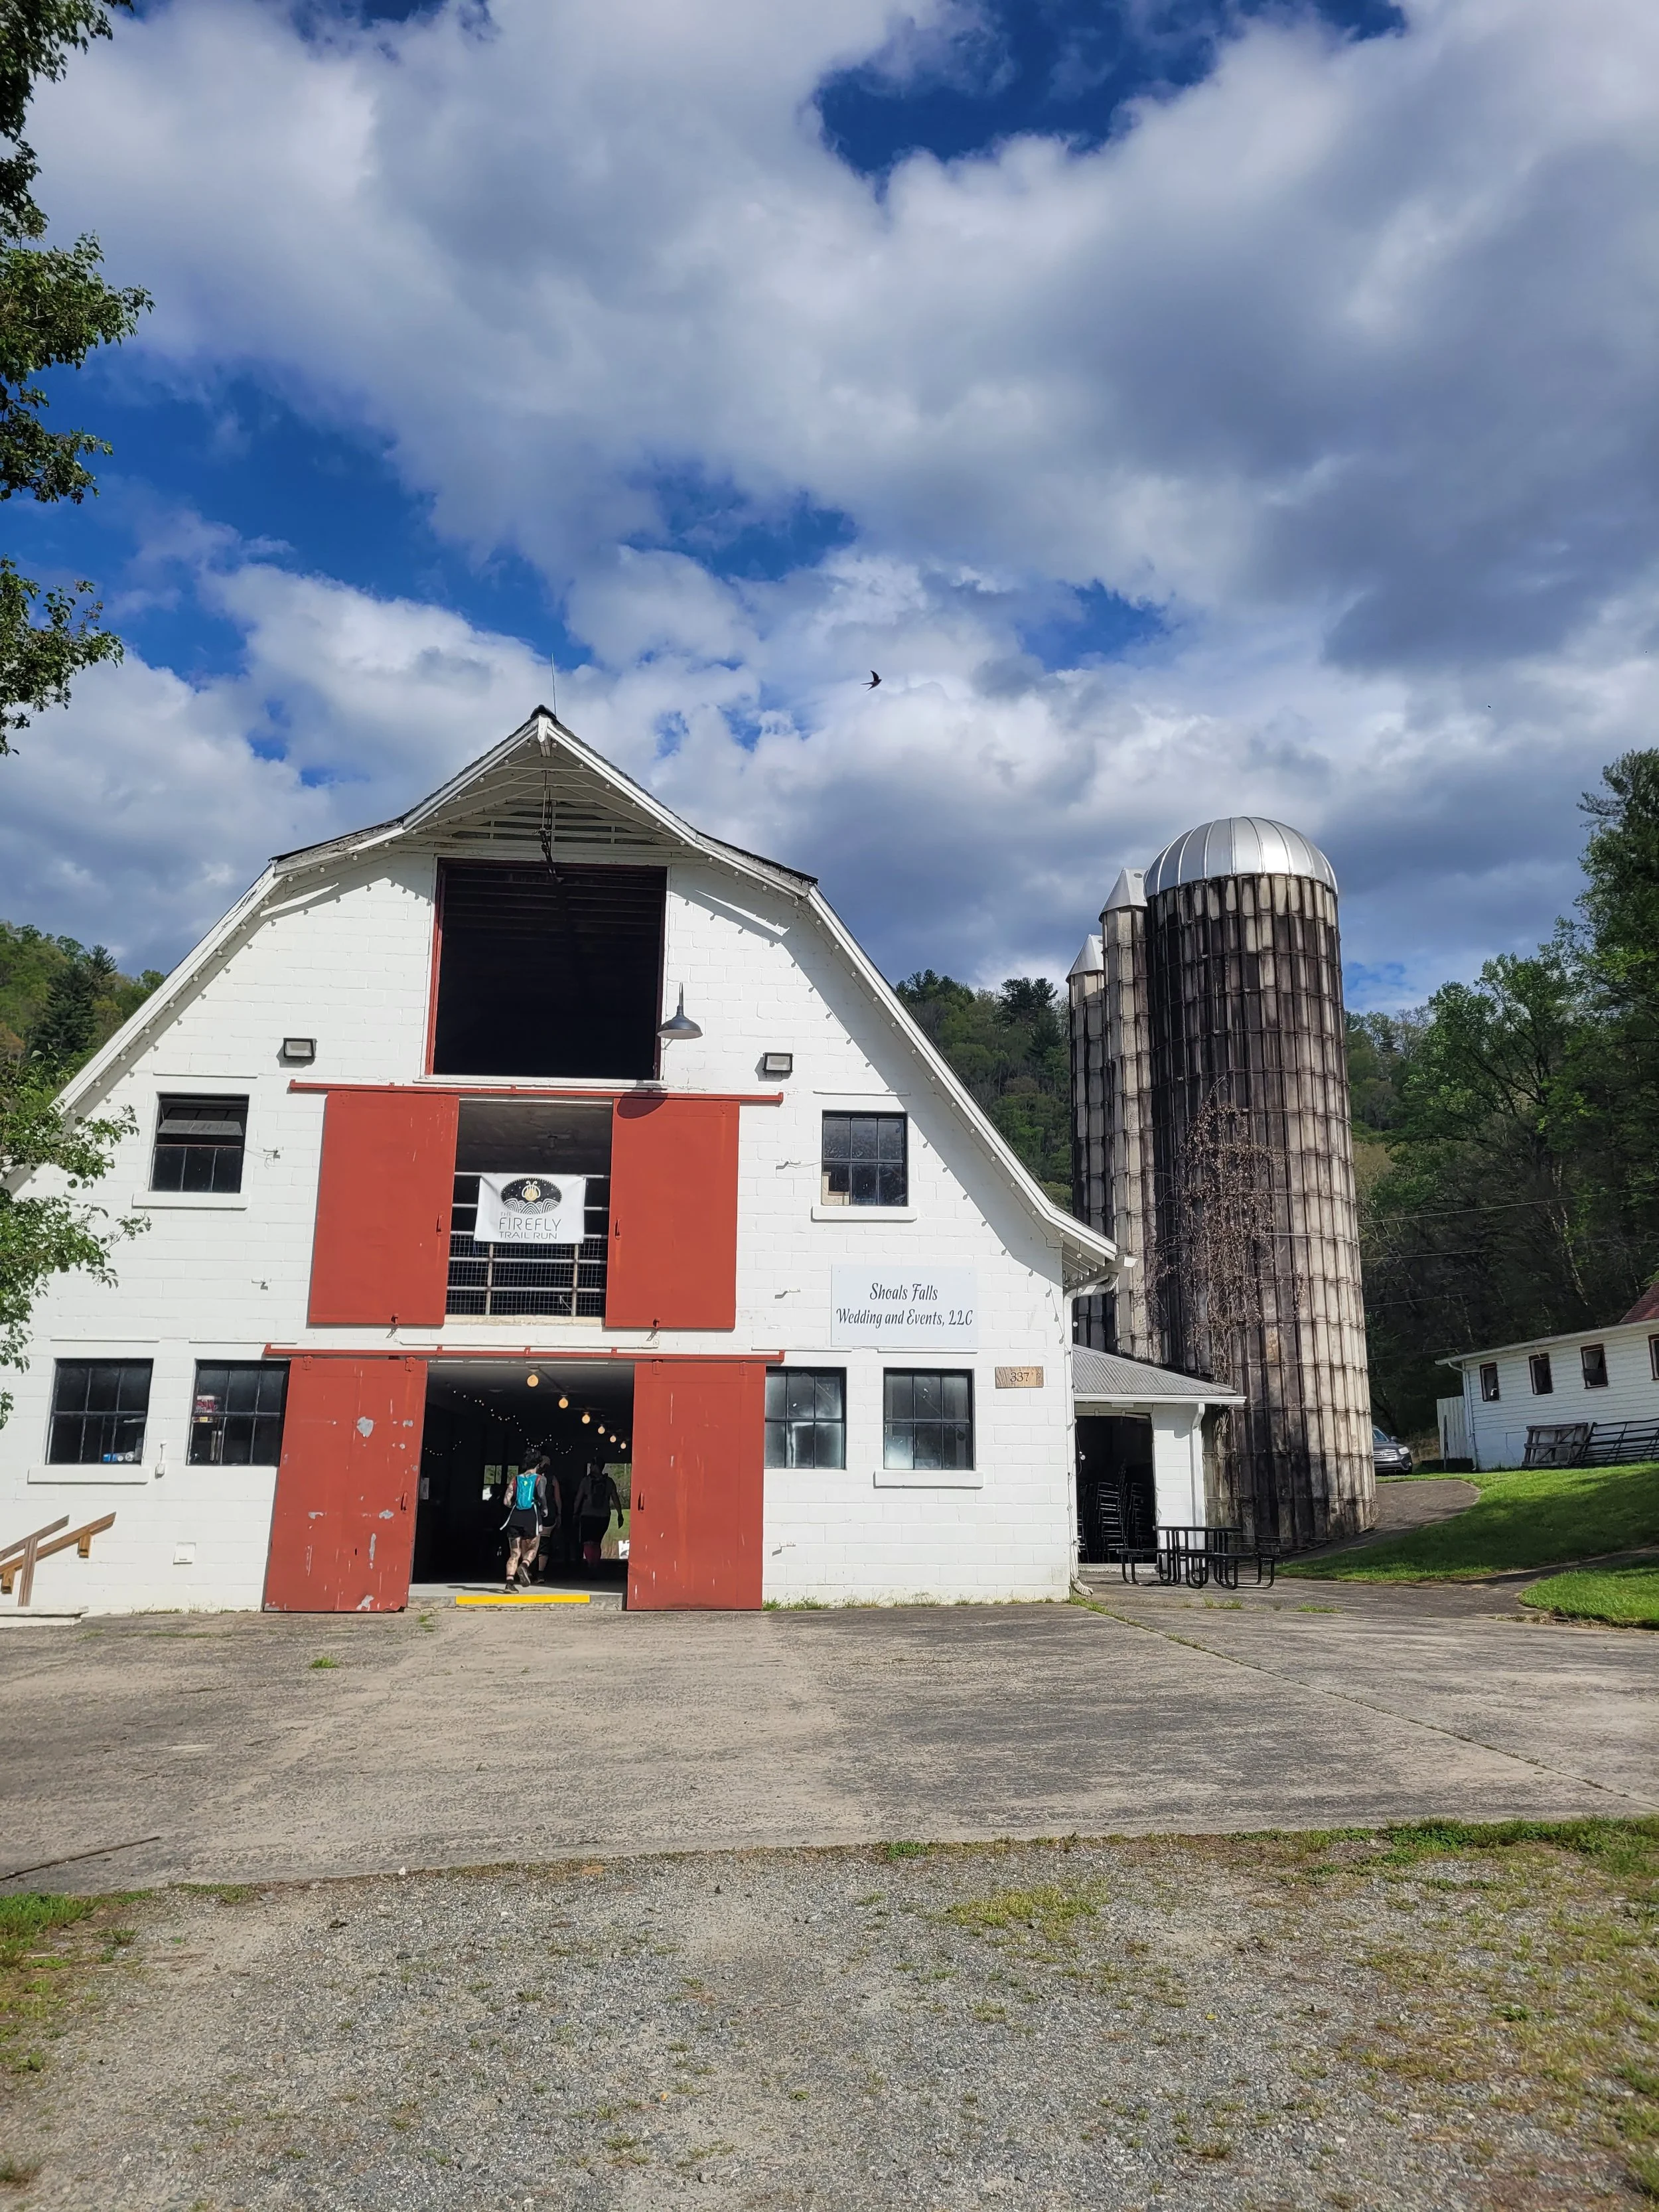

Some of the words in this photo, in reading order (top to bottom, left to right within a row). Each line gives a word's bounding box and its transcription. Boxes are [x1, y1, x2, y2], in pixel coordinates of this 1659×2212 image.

[499, 1217, 561, 1231] FIREFLY
[869, 1282, 908, 1300] Shoals
[911, 1283, 938, 1302] Falls
[836, 1308, 882, 1329] Wedding
[885, 1310, 904, 1325] and
[906, 1309, 945, 1327] Events,
[948, 1310, 974, 1326] LLC
[1009, 1372, 1030, 1382] 337
